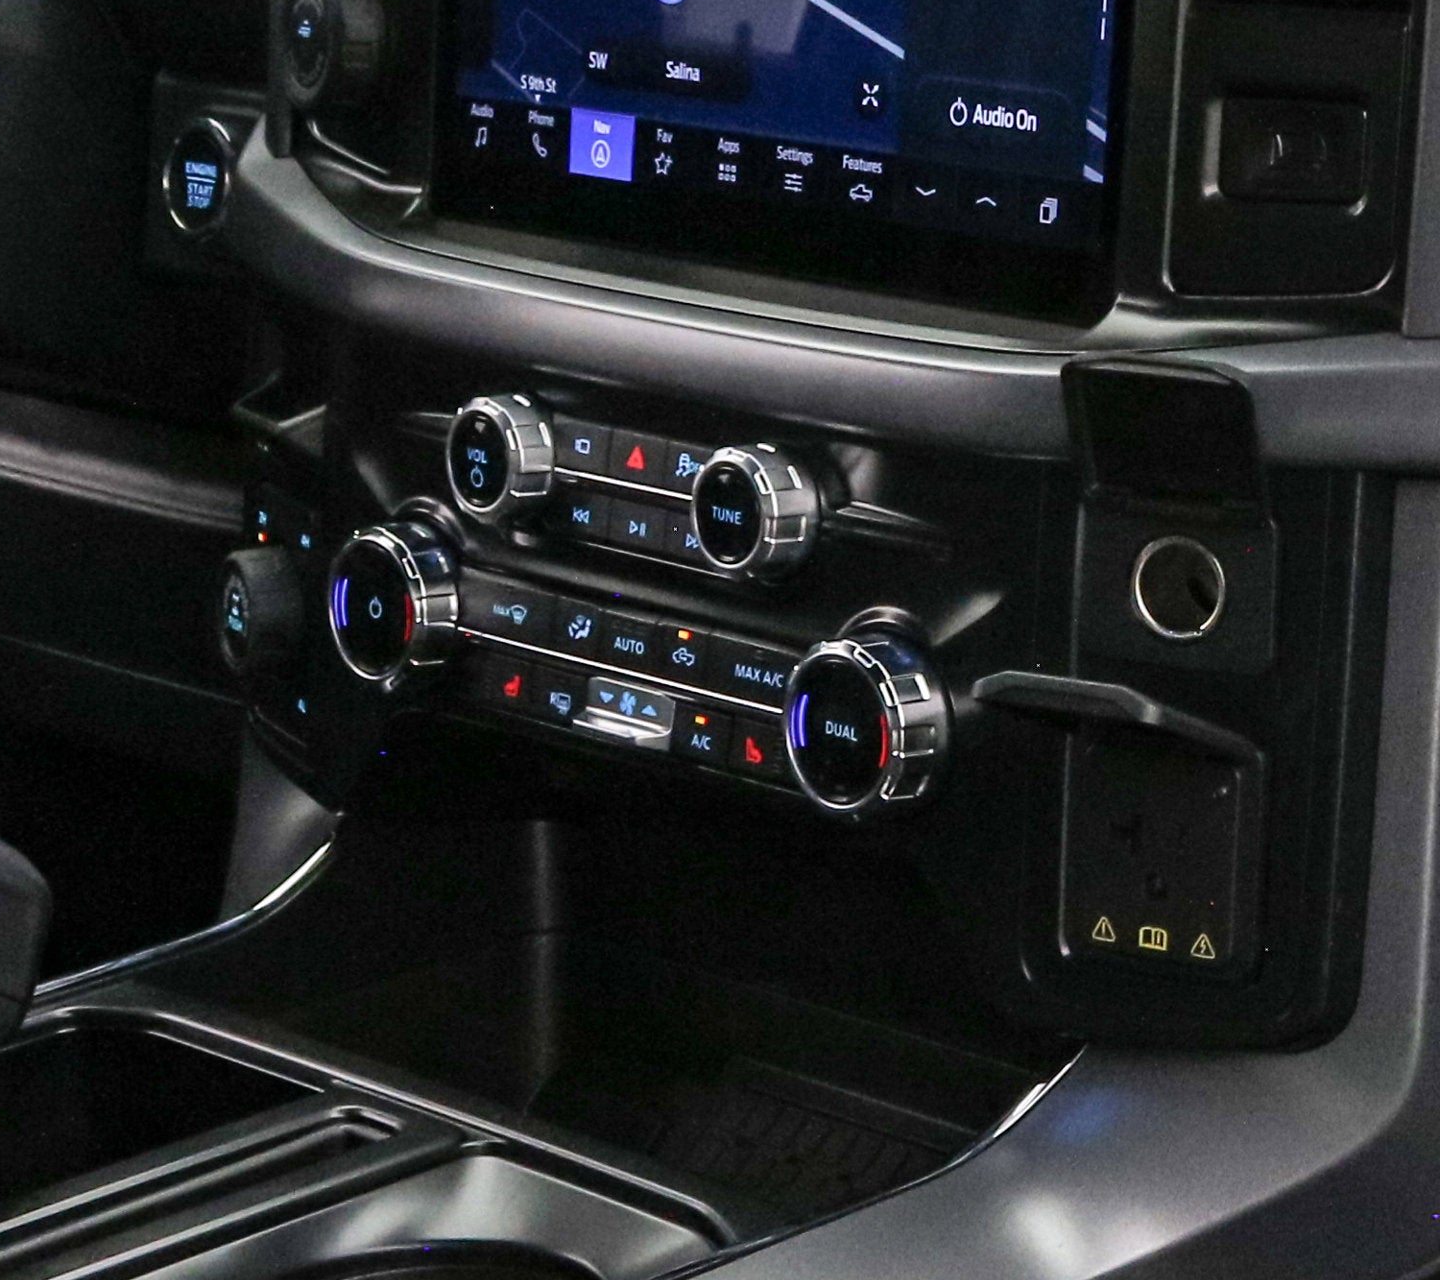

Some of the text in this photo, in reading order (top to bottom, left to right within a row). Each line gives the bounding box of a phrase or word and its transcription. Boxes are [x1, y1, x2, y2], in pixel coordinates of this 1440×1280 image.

[588, 51, 608, 69] SW
[665, 61, 700, 82] Salina
[545, 78, 557, 93] St
[470, 103, 494, 118] Audio
[528, 110, 555, 127] Phone
[972, 103, 1037, 132] Audio On
[657, 128, 673, 143] Fav
[717, 137, 740, 154] Apps
[776, 145, 813, 166] Settings
[842, 155, 883, 174] Features
[187, 183, 213, 196] START
[467, 447, 488, 464] VOL
[712, 505, 742, 525] TUNE
[492, 604, 510, 617] MAX
[613, 636, 645, 655] AUTO
[734, 663, 785, 688] MAX A/C
[825, 720, 858, 742] DUAL
[691, 734, 711, 751] A/C
